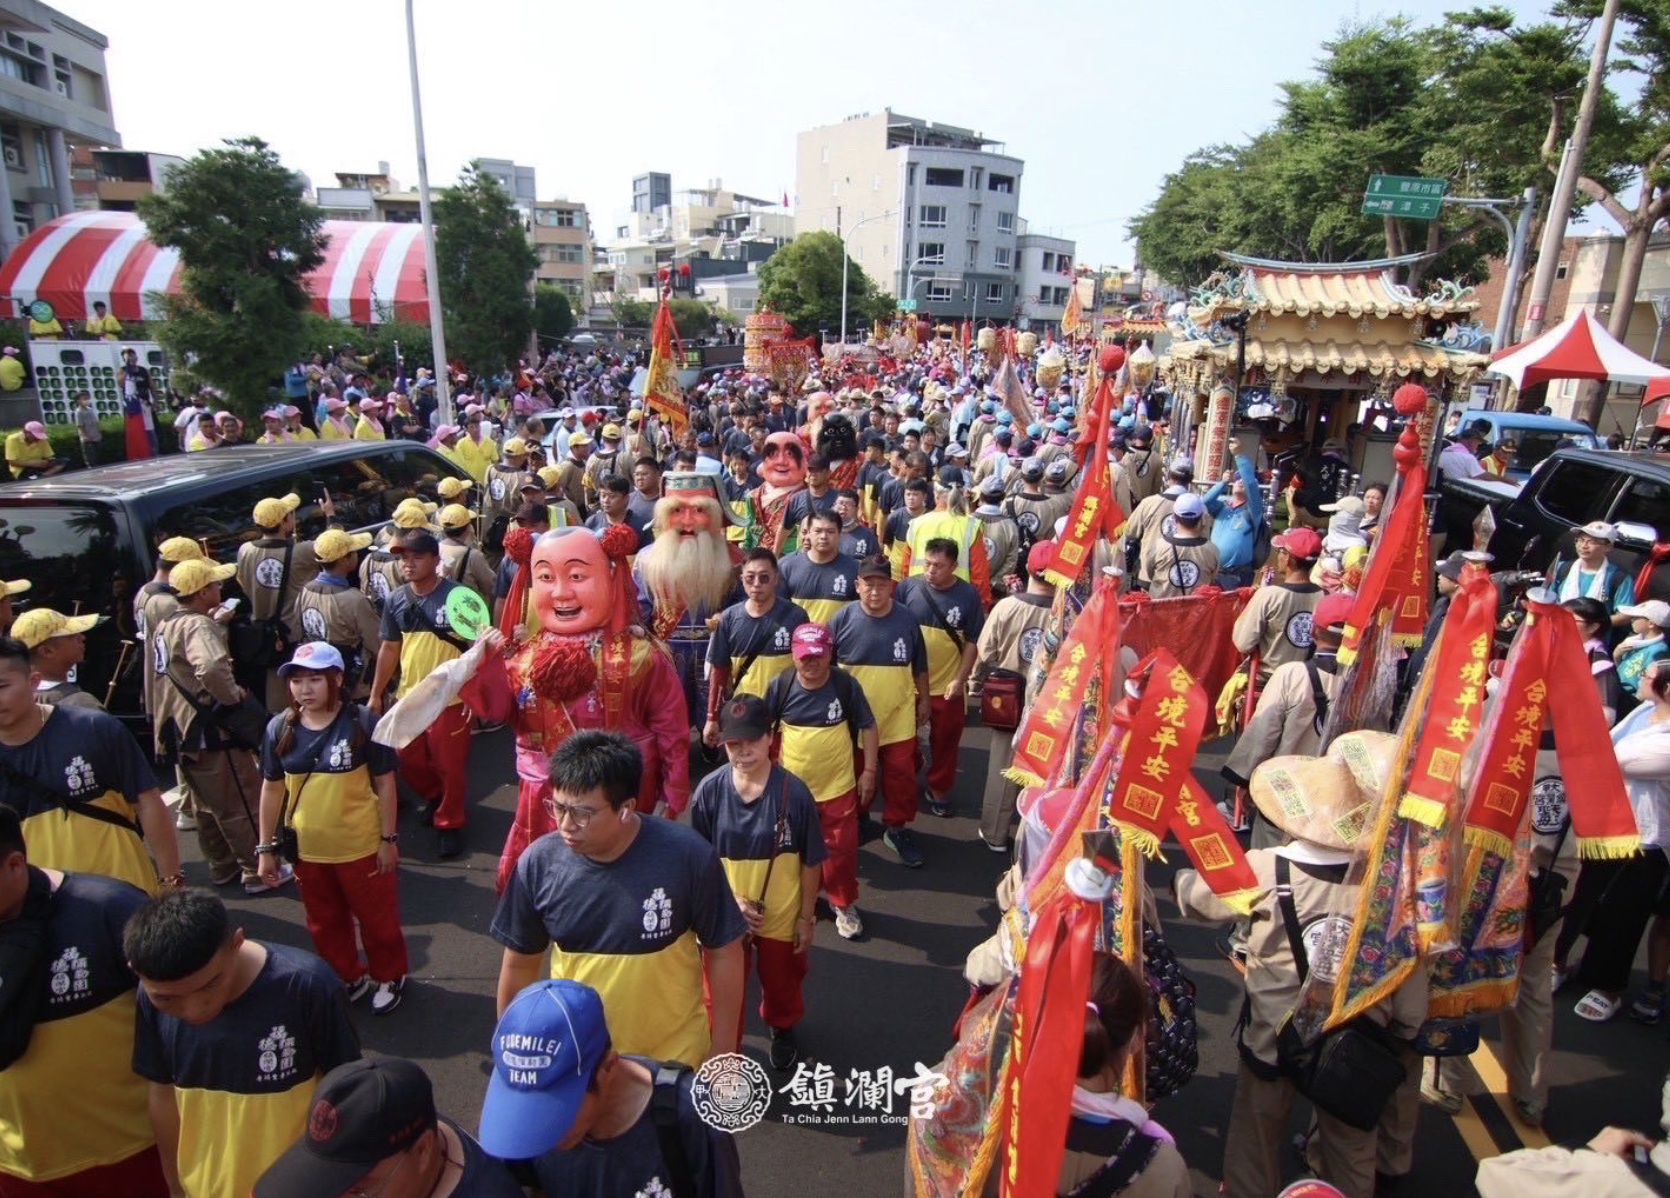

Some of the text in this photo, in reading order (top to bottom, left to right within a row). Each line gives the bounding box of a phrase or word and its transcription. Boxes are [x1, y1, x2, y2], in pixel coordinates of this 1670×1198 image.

[1045, 642, 1087, 728] 合境平安
[1140, 663, 1195, 782] 合境平安
[1446, 632, 1488, 742] 合境平安
[1502, 678, 1547, 780] 合境平安
[509, 1069, 537, 1084] TEAM
